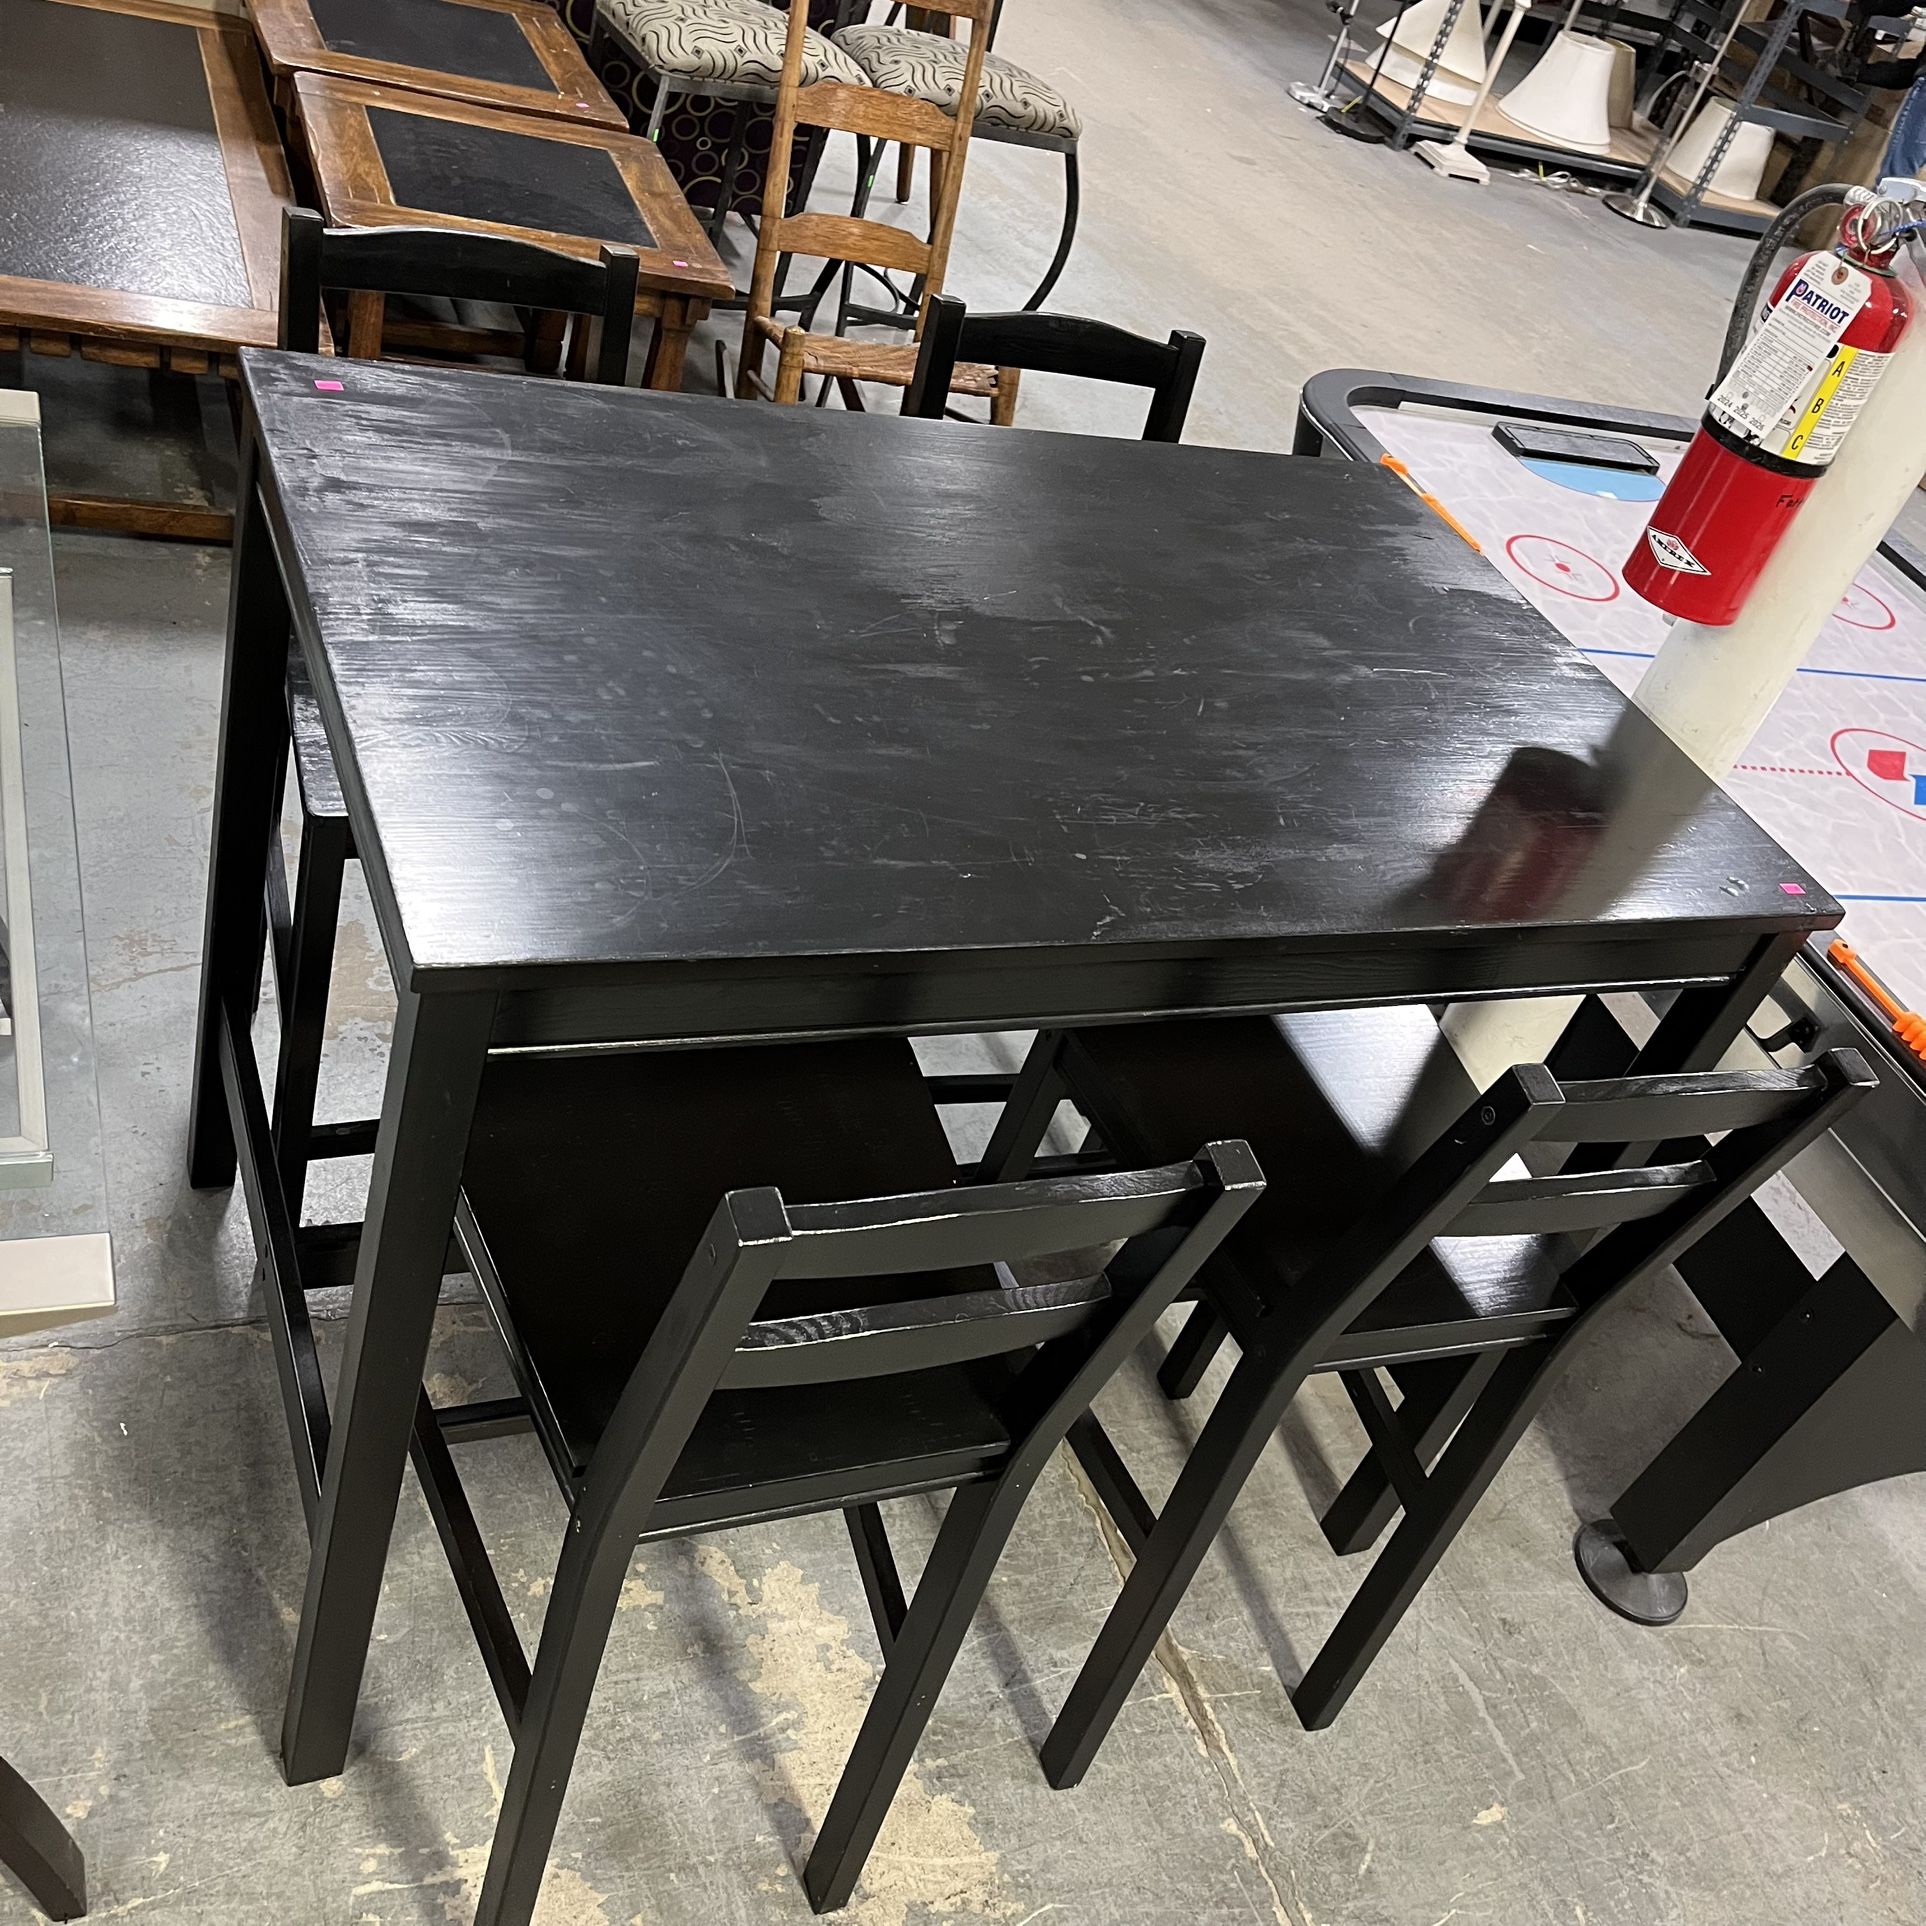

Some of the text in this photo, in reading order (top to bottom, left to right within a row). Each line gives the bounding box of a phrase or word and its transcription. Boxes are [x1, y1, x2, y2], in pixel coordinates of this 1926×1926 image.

[1785, 278, 1849, 324] PATRIOT
[1832, 361, 1846, 378] A
[1811, 397, 1825, 414] B
[1791, 435, 1804, 450] C
